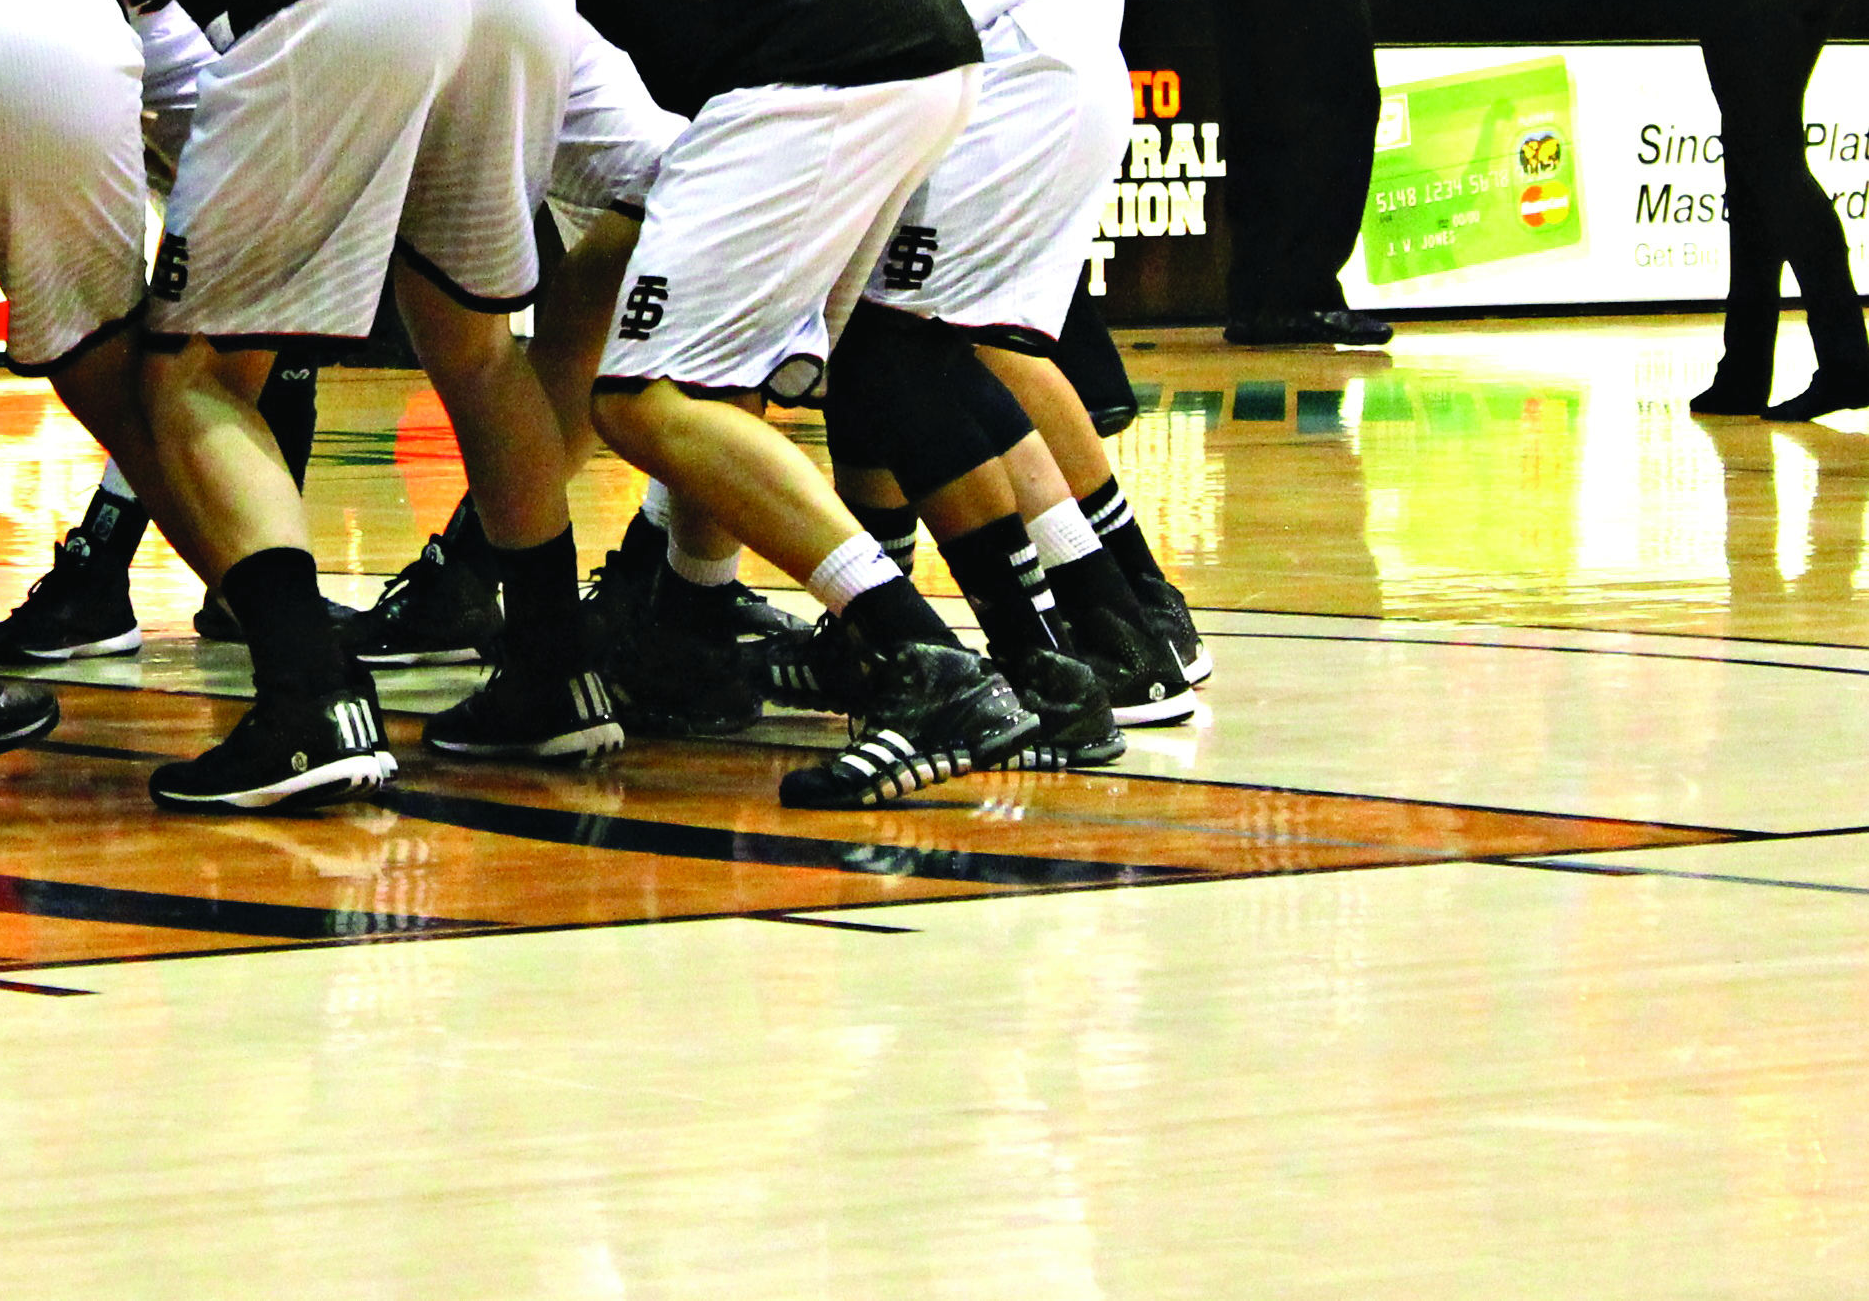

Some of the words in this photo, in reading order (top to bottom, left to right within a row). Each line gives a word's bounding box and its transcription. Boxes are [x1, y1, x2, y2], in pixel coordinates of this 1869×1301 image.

[1376, 186, 1418, 214] 5148
[1424, 175, 1464, 204] 1234
[1421, 230, 1457, 250] JONES
